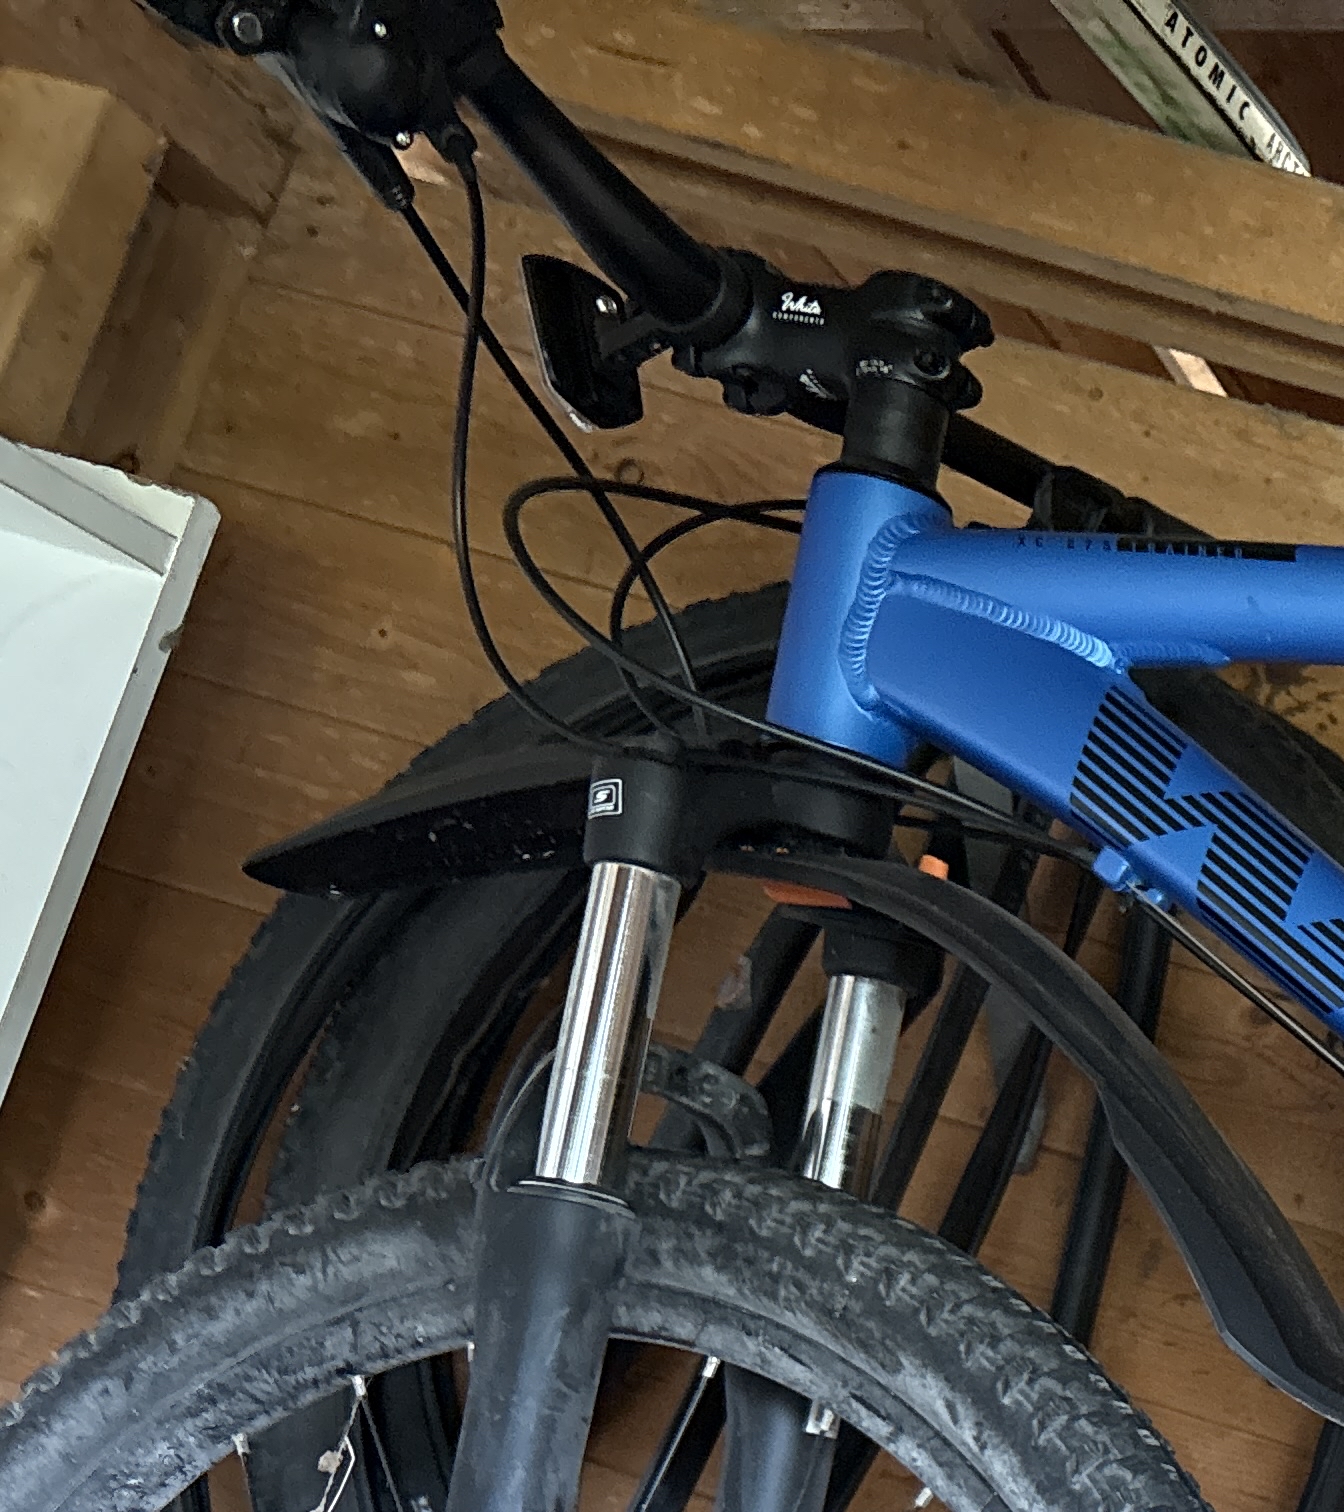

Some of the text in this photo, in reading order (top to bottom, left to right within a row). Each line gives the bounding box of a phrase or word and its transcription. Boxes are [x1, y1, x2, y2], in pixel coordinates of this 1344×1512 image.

[1162, 9, 1308, 177] ATOMIC ARCT
[781, 291, 822, 315] White
